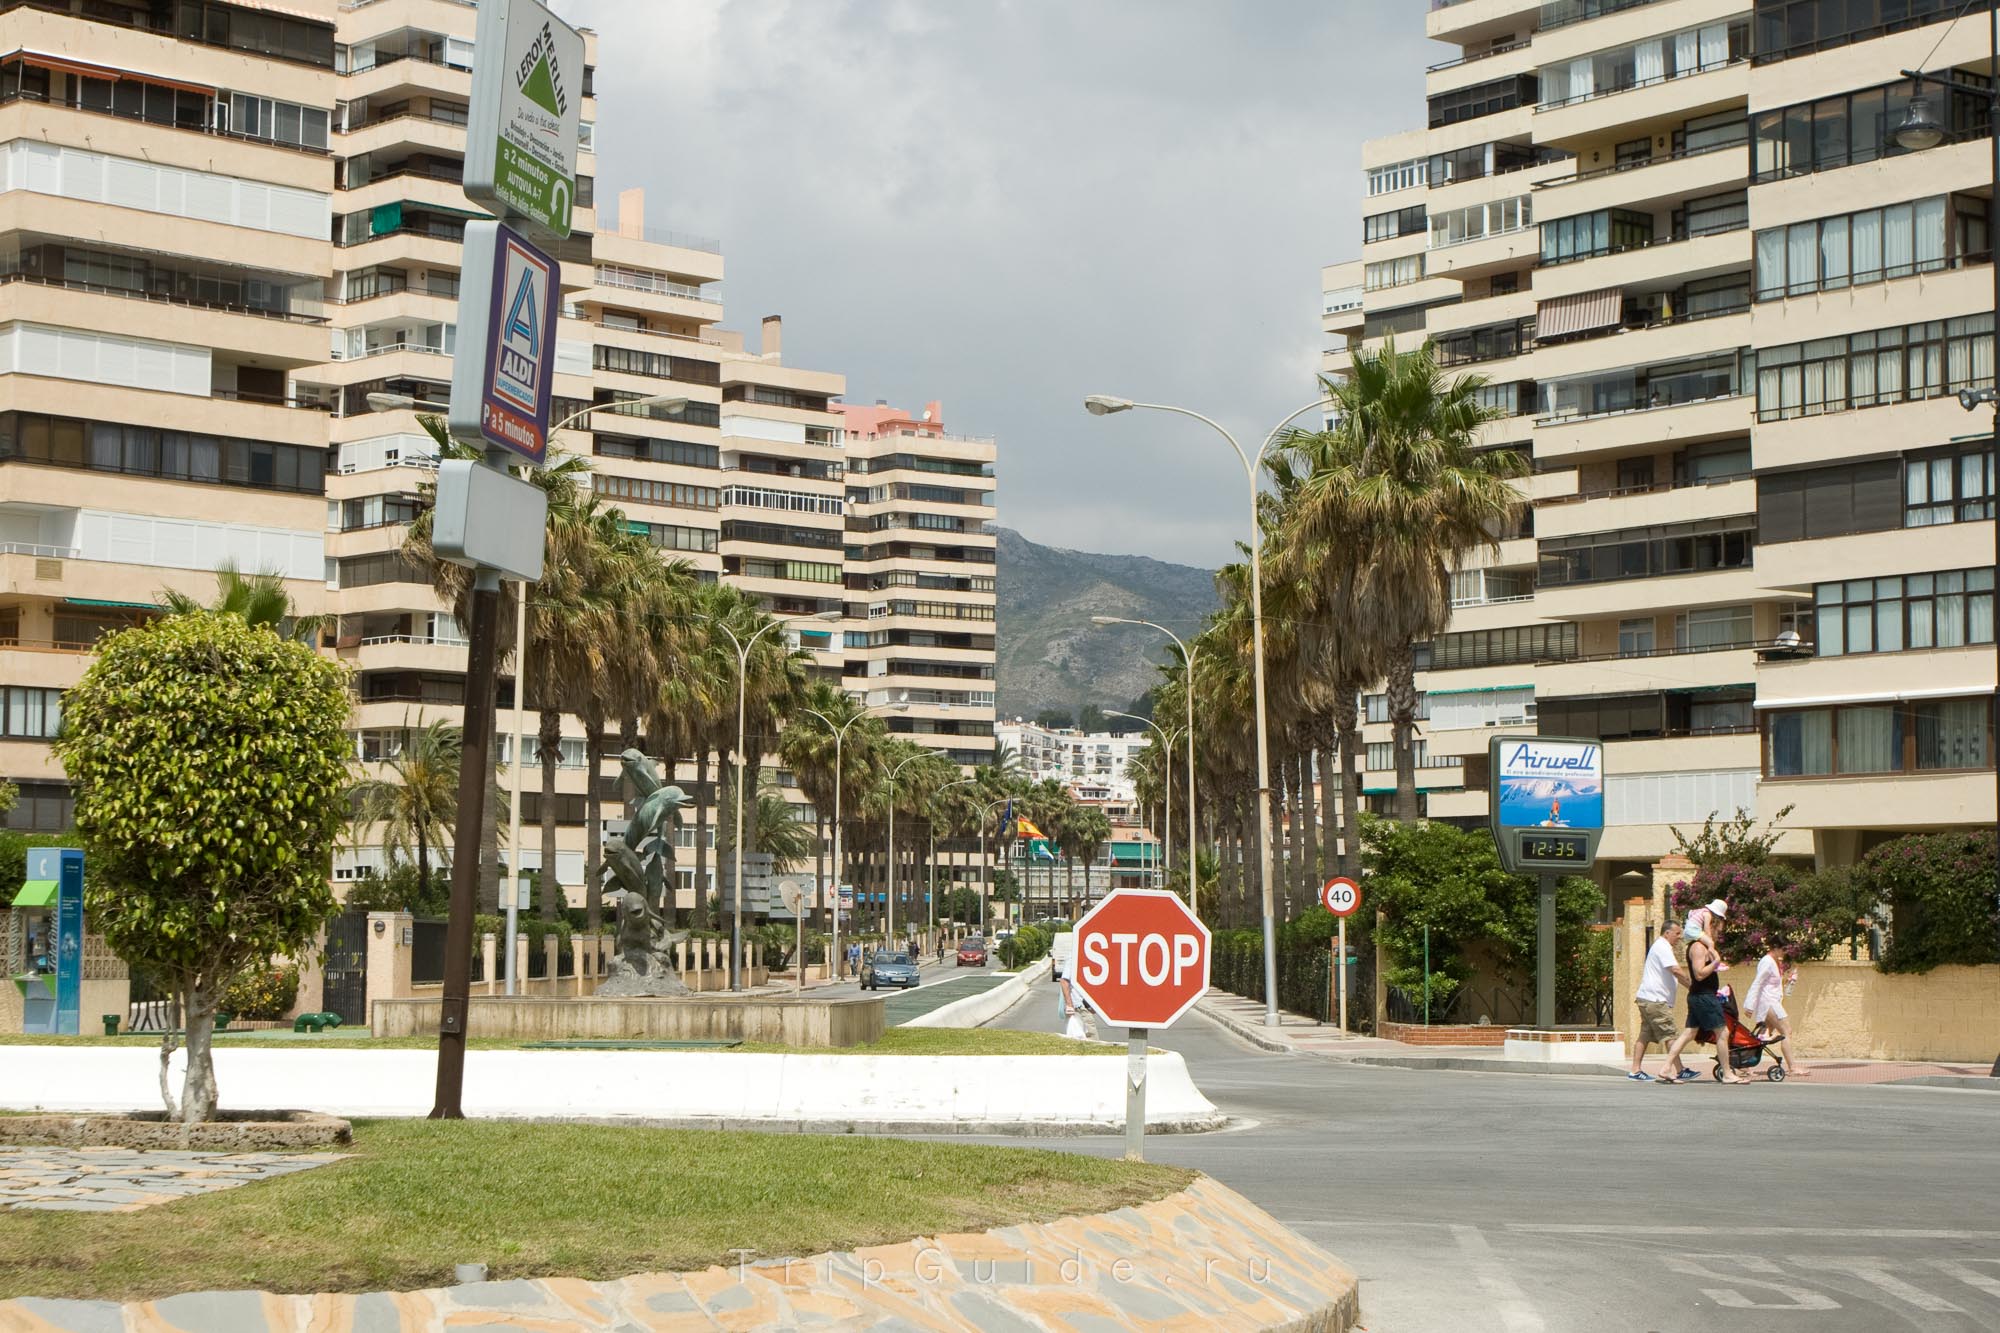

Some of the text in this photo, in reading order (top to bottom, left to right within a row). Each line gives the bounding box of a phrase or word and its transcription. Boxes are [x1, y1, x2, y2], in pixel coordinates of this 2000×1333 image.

[516, 32, 543, 88] LEROY
[542, 21, 567, 116] MERLIN
[504, 148, 549, 185] a 2 minutos
[532, 186, 542, 201] A-7
[502, 350, 533, 386] ALDI
[483, 403, 535, 449] P a 5 minutos
[1507, 743, 1596, 770] Airwell
[1531, 842, 1575, 857] 12:35
[1331, 890, 1352, 903] 40
[1082, 932, 1200, 987] STOP
